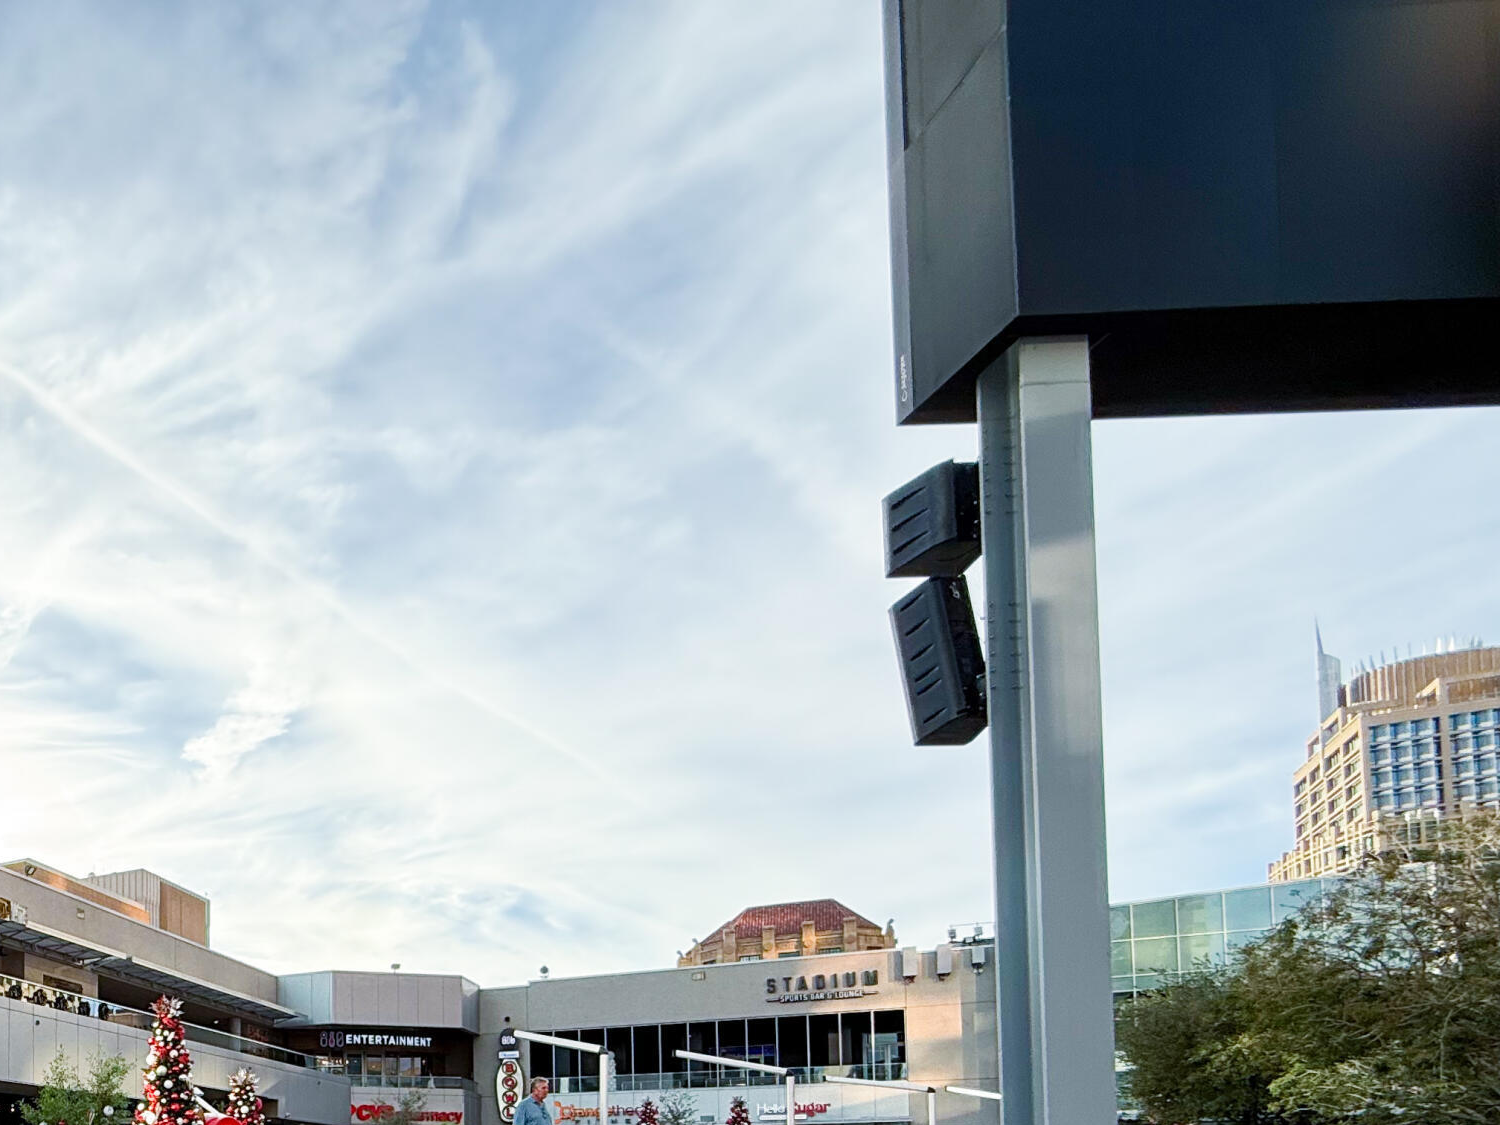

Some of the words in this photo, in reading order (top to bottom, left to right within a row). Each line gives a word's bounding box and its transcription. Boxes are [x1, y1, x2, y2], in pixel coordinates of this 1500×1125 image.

[766, 970, 879, 994] STADIUM
[780, 994, 808, 1003] SPORTS
[810, 993, 825, 1001] BAR
[835, 990, 864, 999] LOUNGE
[345, 1034, 432, 1047] ENTERTAINMENT
[357, 1105, 393, 1121] CVS
[756, 1103, 785, 1116] Hello
